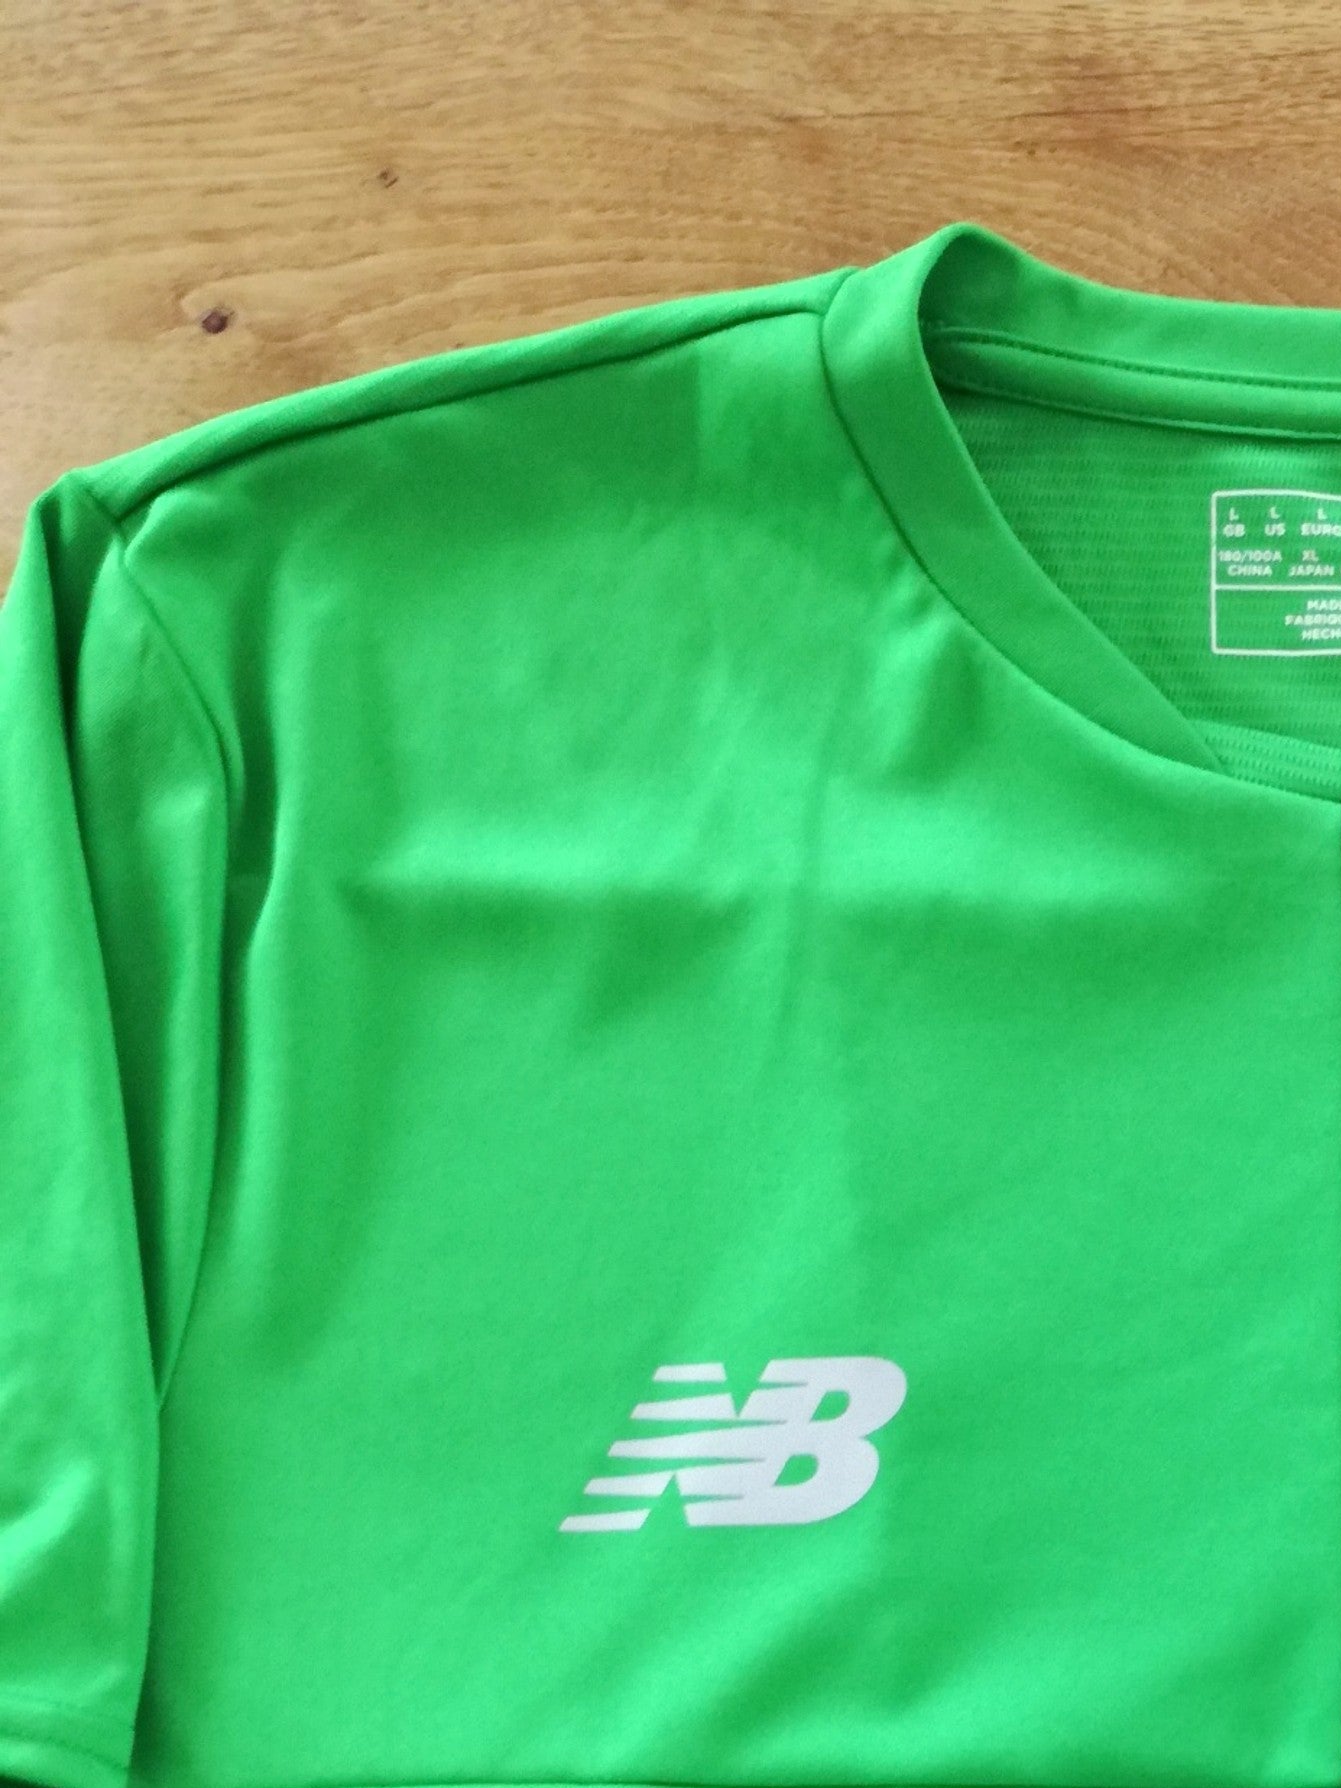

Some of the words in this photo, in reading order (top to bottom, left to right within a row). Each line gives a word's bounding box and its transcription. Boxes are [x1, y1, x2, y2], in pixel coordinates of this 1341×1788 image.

[1229, 507, 1240, 521] L
[1270, 505, 1281, 519] L
[1317, 507, 1328, 520] L
[1223, 524, 1246, 538] GB
[1264, 523, 1286, 537] US
[1227, 564, 1273, 577] CHINA
[1288, 564, 1335, 577] JAPAN
